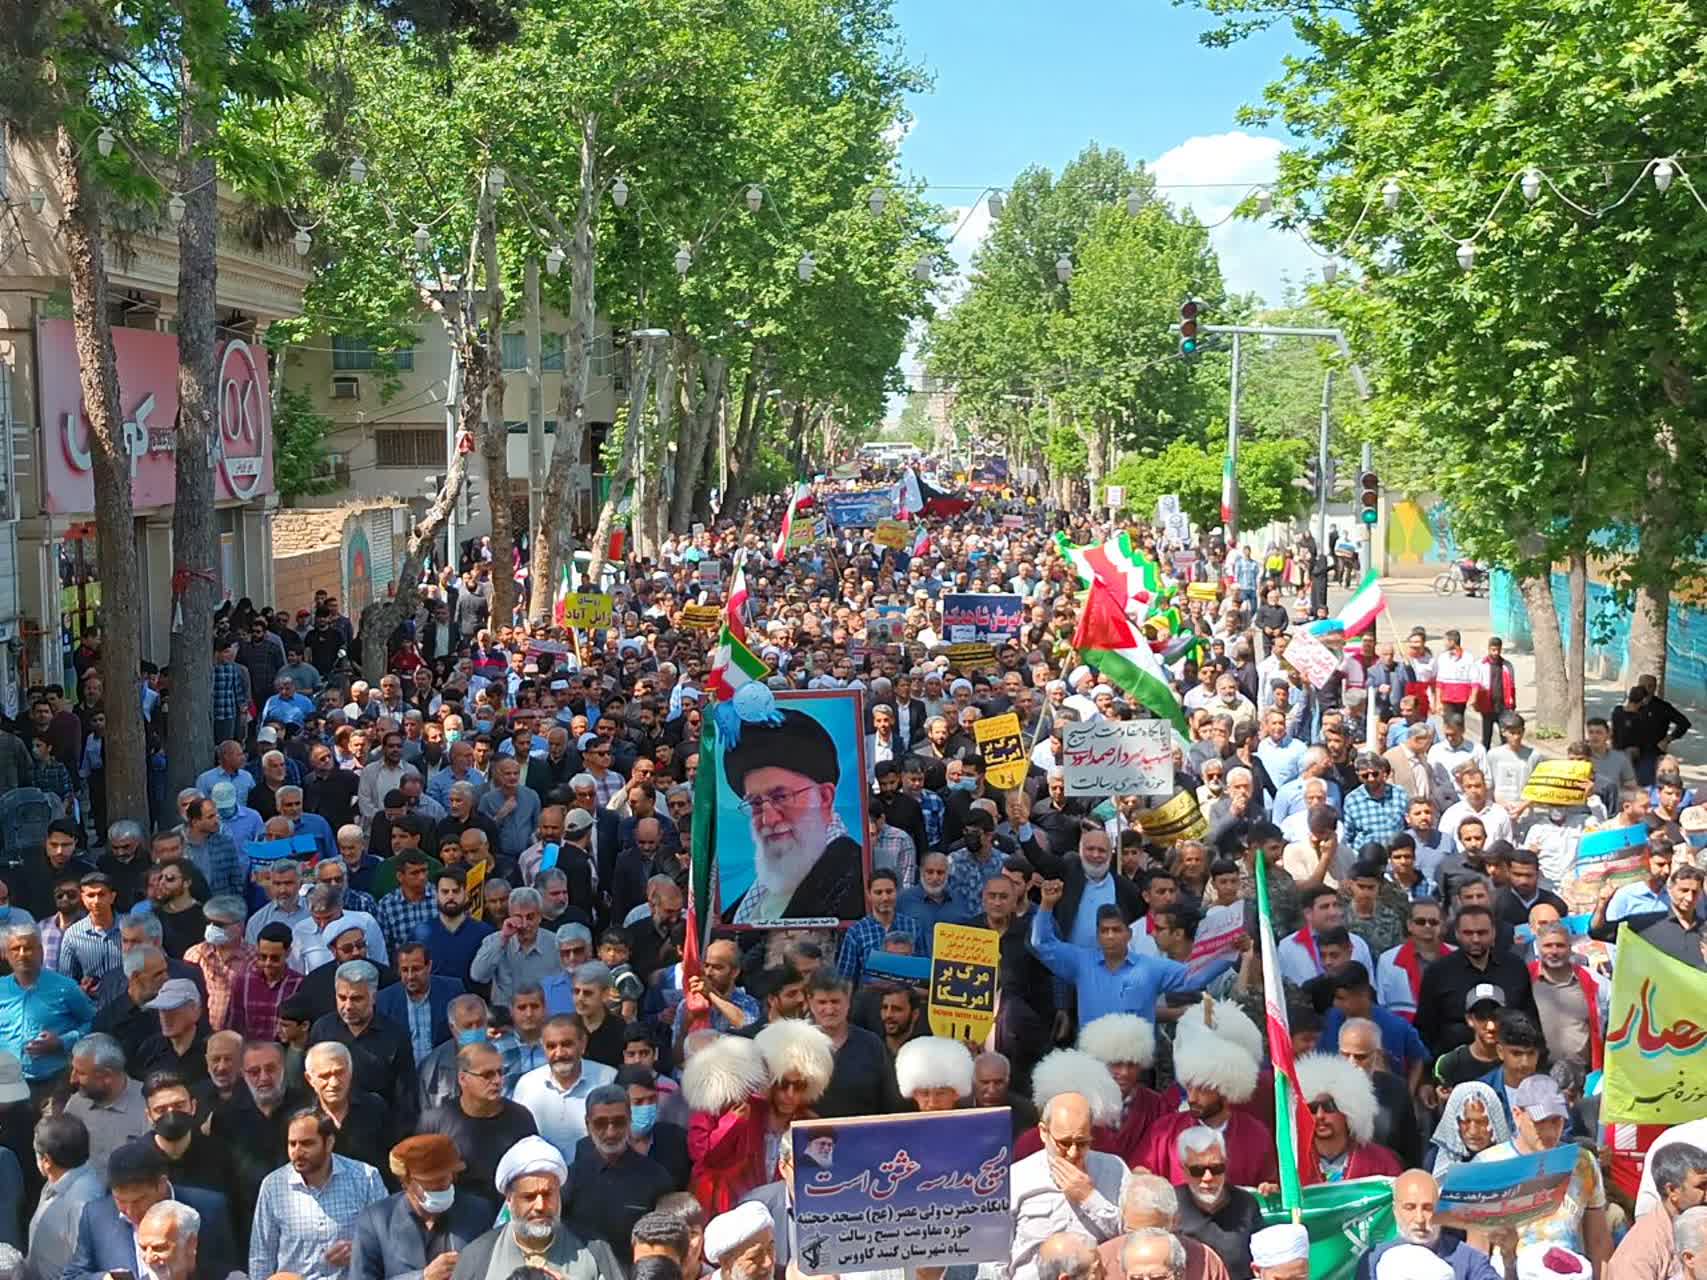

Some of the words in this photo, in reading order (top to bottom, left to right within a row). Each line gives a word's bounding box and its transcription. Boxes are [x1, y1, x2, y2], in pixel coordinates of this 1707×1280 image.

[225, 378, 255, 441] OK
[566, 607, 586, 620] آباد
[1067, 723, 1097, 747] بسیج
[1095, 724, 1143, 738] مقاومت
[1141, 721, 1167, 743] پایگاه
[979, 742, 993, 754] بر
[994, 736, 1018, 750] مرگ
[1107, 745, 1145, 768] سردار
[1140, 743, 1171, 770] شهید
[1071, 776, 1116, 790] رسالت
[1145, 776, 1165, 789] حوزه
[939, 966, 953, 983] بر
[956, 965, 991, 986] مرگ
[870, 1149, 921, 1199] عشق
[972, 1146, 1008, 1197] بسیج
[804, 1169, 870, 1197] است
[896, 1208, 918, 1221] عصر
[919, 1205, 942, 1220] ولی
[944, 1204, 979, 1219] حضرت
[981, 1199, 1010, 1215] پایگاه
[832, 1213, 864, 1224] مسجد
[866, 1206, 894, 1224] (عج)
[838, 1228, 873, 1244] رسالت
[874, 1229, 900, 1241] بسیج
[903, 1225, 942, 1239] مقاومت
[945, 1223, 972, 1239] حوزه
[838, 1248, 875, 1265] کاووس
[876, 1245, 900, 1259] گنبد
[902, 1245, 946, 1260] شهرستان
[947, 1243, 970, 1255] سپاه
